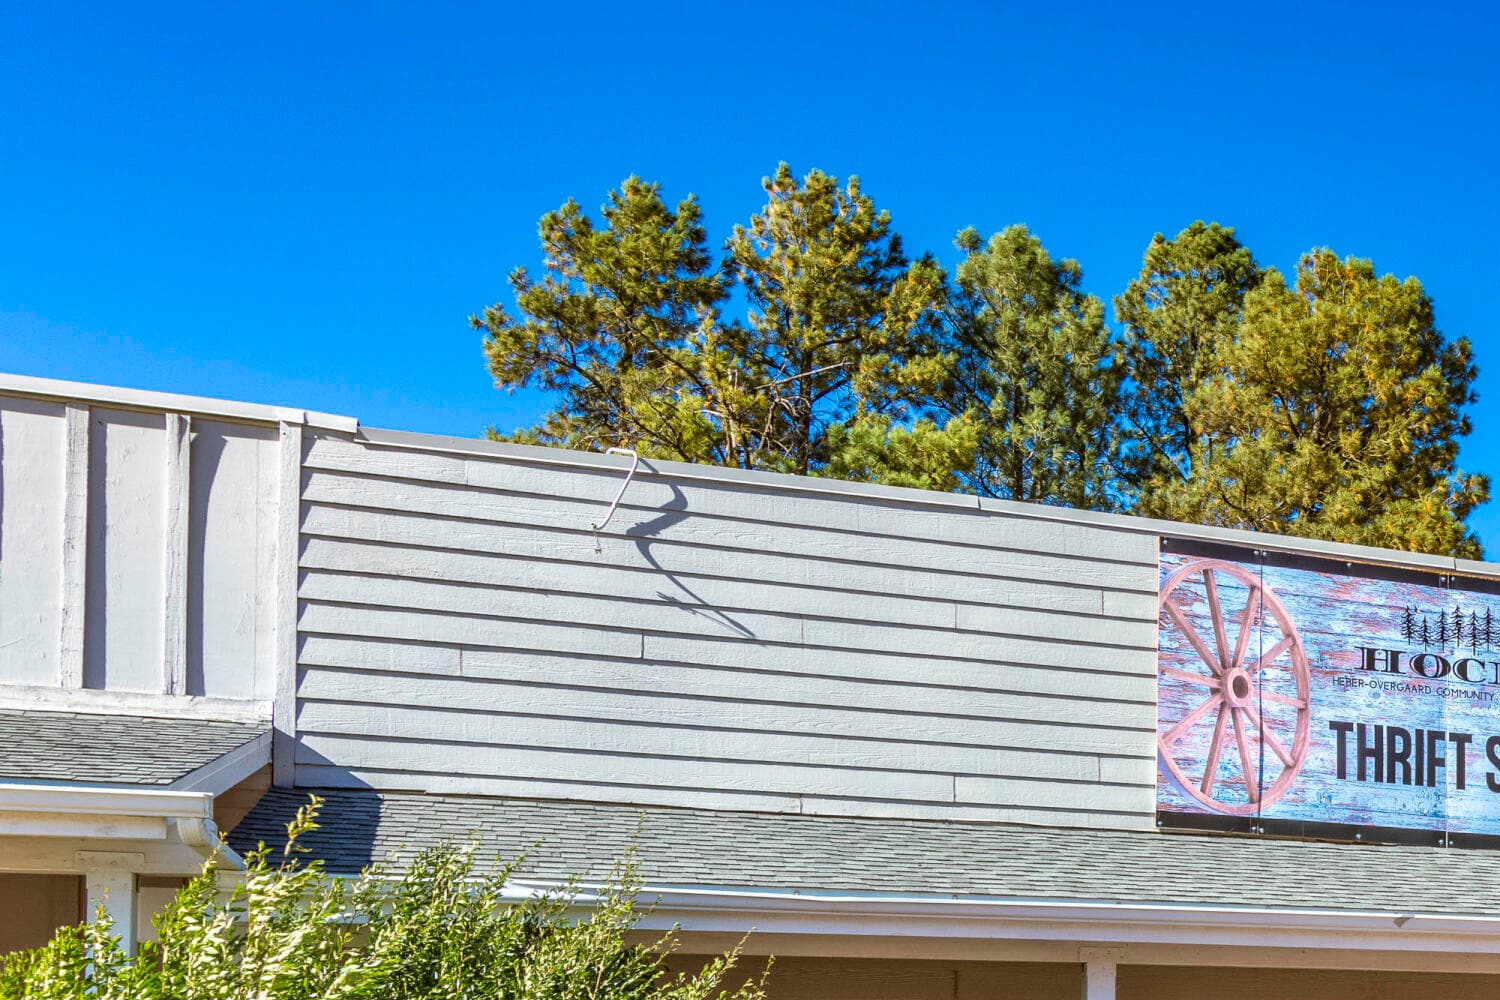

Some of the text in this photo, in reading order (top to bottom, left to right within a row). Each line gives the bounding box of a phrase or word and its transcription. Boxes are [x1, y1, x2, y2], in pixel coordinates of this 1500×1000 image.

[1332, 676, 1432, 695] HEBER-OVERGAARD
[1436, 687, 1495, 702] COMMUNITY
[1329, 720, 1473, 790] THRIFT
